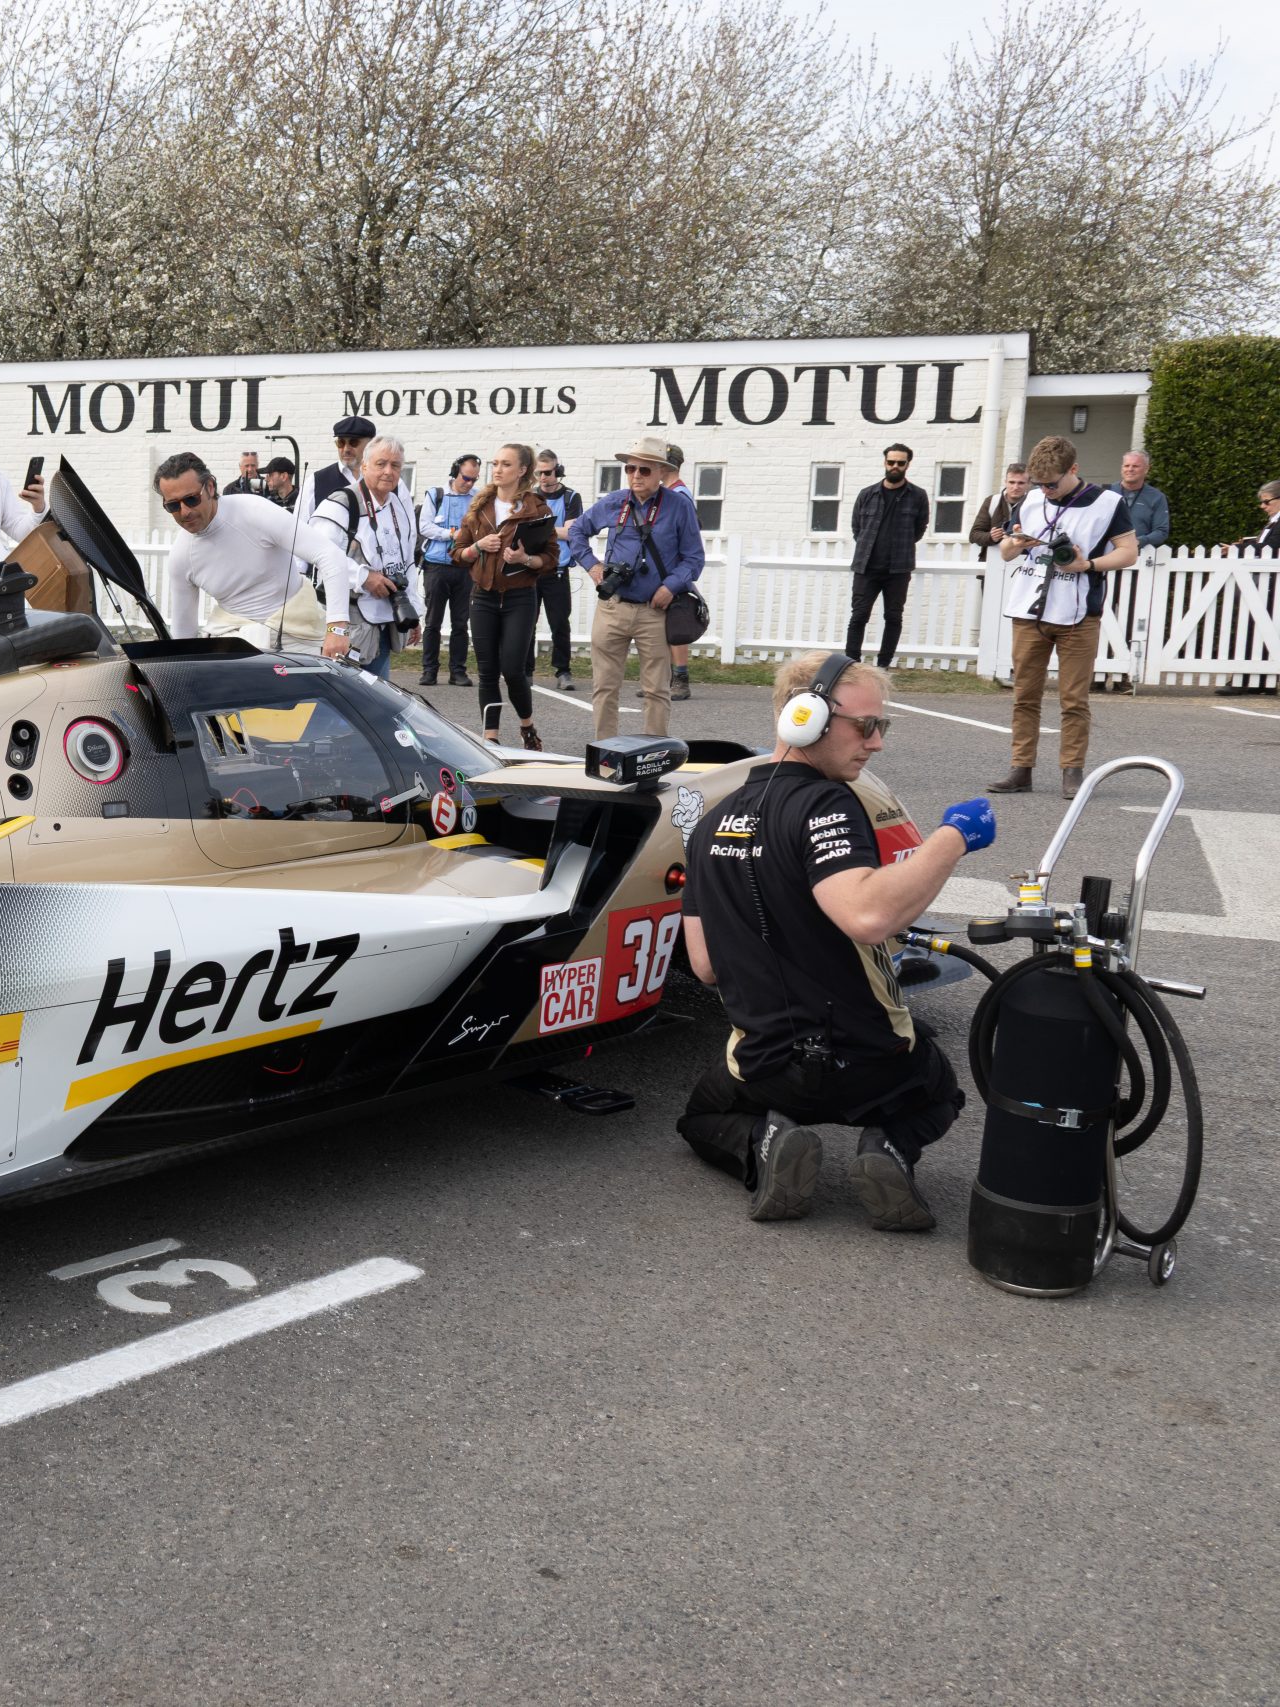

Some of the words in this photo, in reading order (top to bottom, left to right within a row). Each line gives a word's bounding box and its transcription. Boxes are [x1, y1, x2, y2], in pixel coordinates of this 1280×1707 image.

[27, 377, 282, 436] MOTUL
[342, 388, 479, 418] MOTOR
[488, 386, 577, 415] OILS
[646, 362, 983, 427] MOTUL
[636, 760, 671, 771] CADILLAC
[636, 766, 663, 777] RACING
[435, 793, 453, 832] E
[465, 812, 474, 827] N
[809, 813, 848, 829] Hertz
[810, 828, 837, 844] Mobil
[814, 840, 851, 853] JOTA
[616, 911, 682, 1004] 38
[544, 963, 597, 993] HYPER
[76, 927, 360, 1066] Hertz
[543, 985, 595, 1027] CAR
[448, 1015, 510, 1046] Singer
[760, 1124, 778, 1163] HOKA
